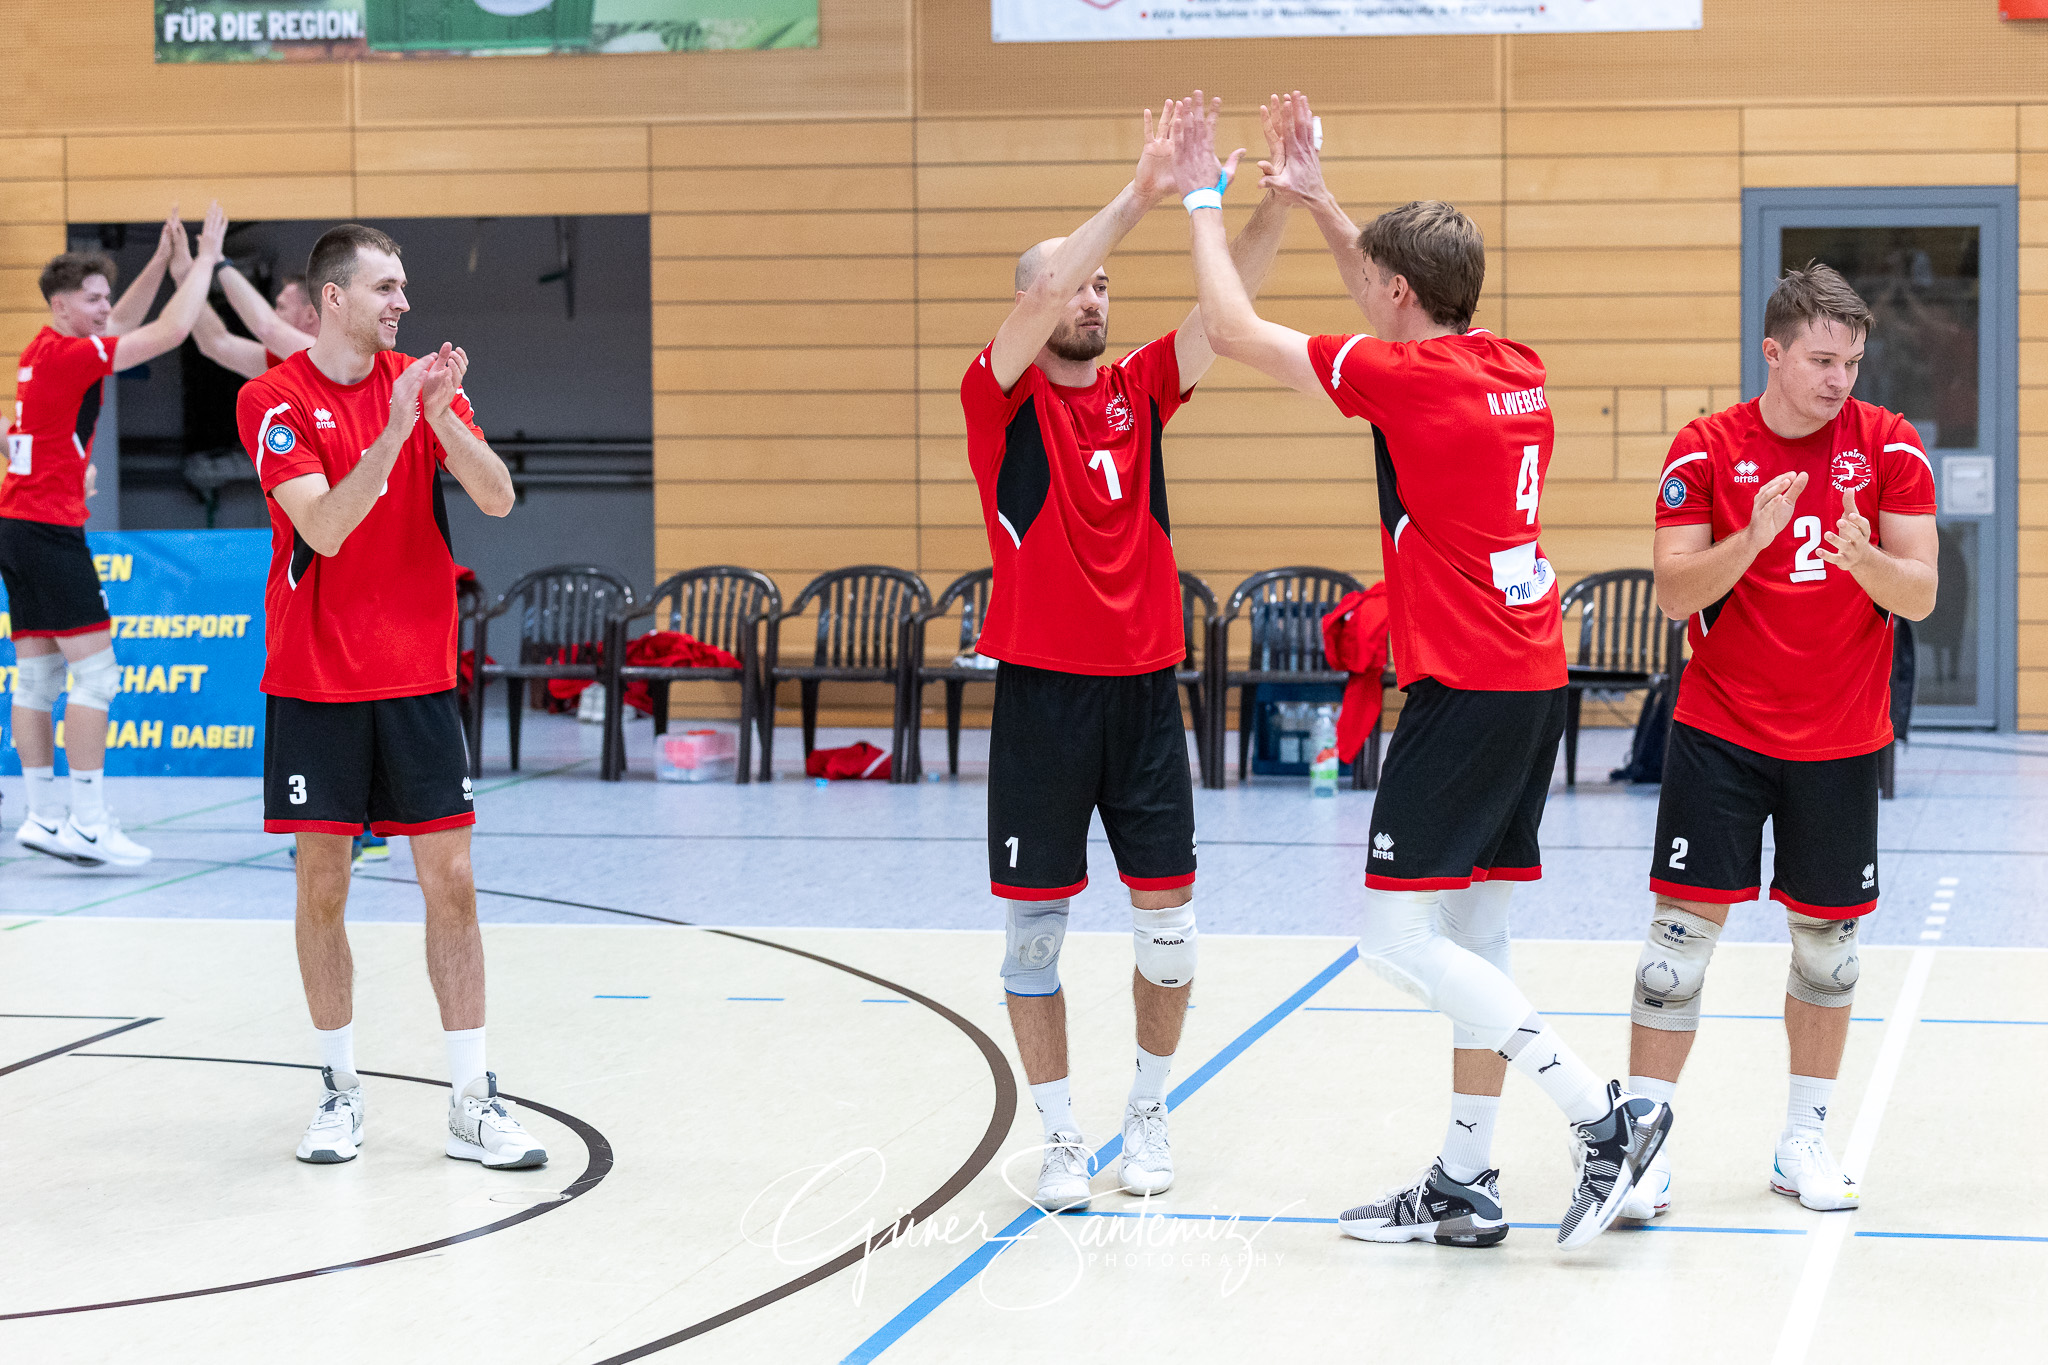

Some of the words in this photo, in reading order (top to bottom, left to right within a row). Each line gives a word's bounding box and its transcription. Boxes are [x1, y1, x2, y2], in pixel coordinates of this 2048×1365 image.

[164, 7, 216, 42] FÜR
[220, 12, 263, 41] DIE
[267, 9, 366, 40] REGION.
[1487, 386, 1547, 415] N.WEBER
[316, 420, 336, 429] errea
[1088, 449, 1122, 500] 1
[1516, 445, 1539, 525] 4
[1734, 475, 1759, 483] errea
[1794, 516, 1825, 571] 2
[171, 725, 255, 748] DABEI!!
[288, 775, 307, 804] 3
[1005, 836, 1019, 868] 1
[1372, 849, 1394, 861] errea
[1669, 837, 1689, 870] 2
